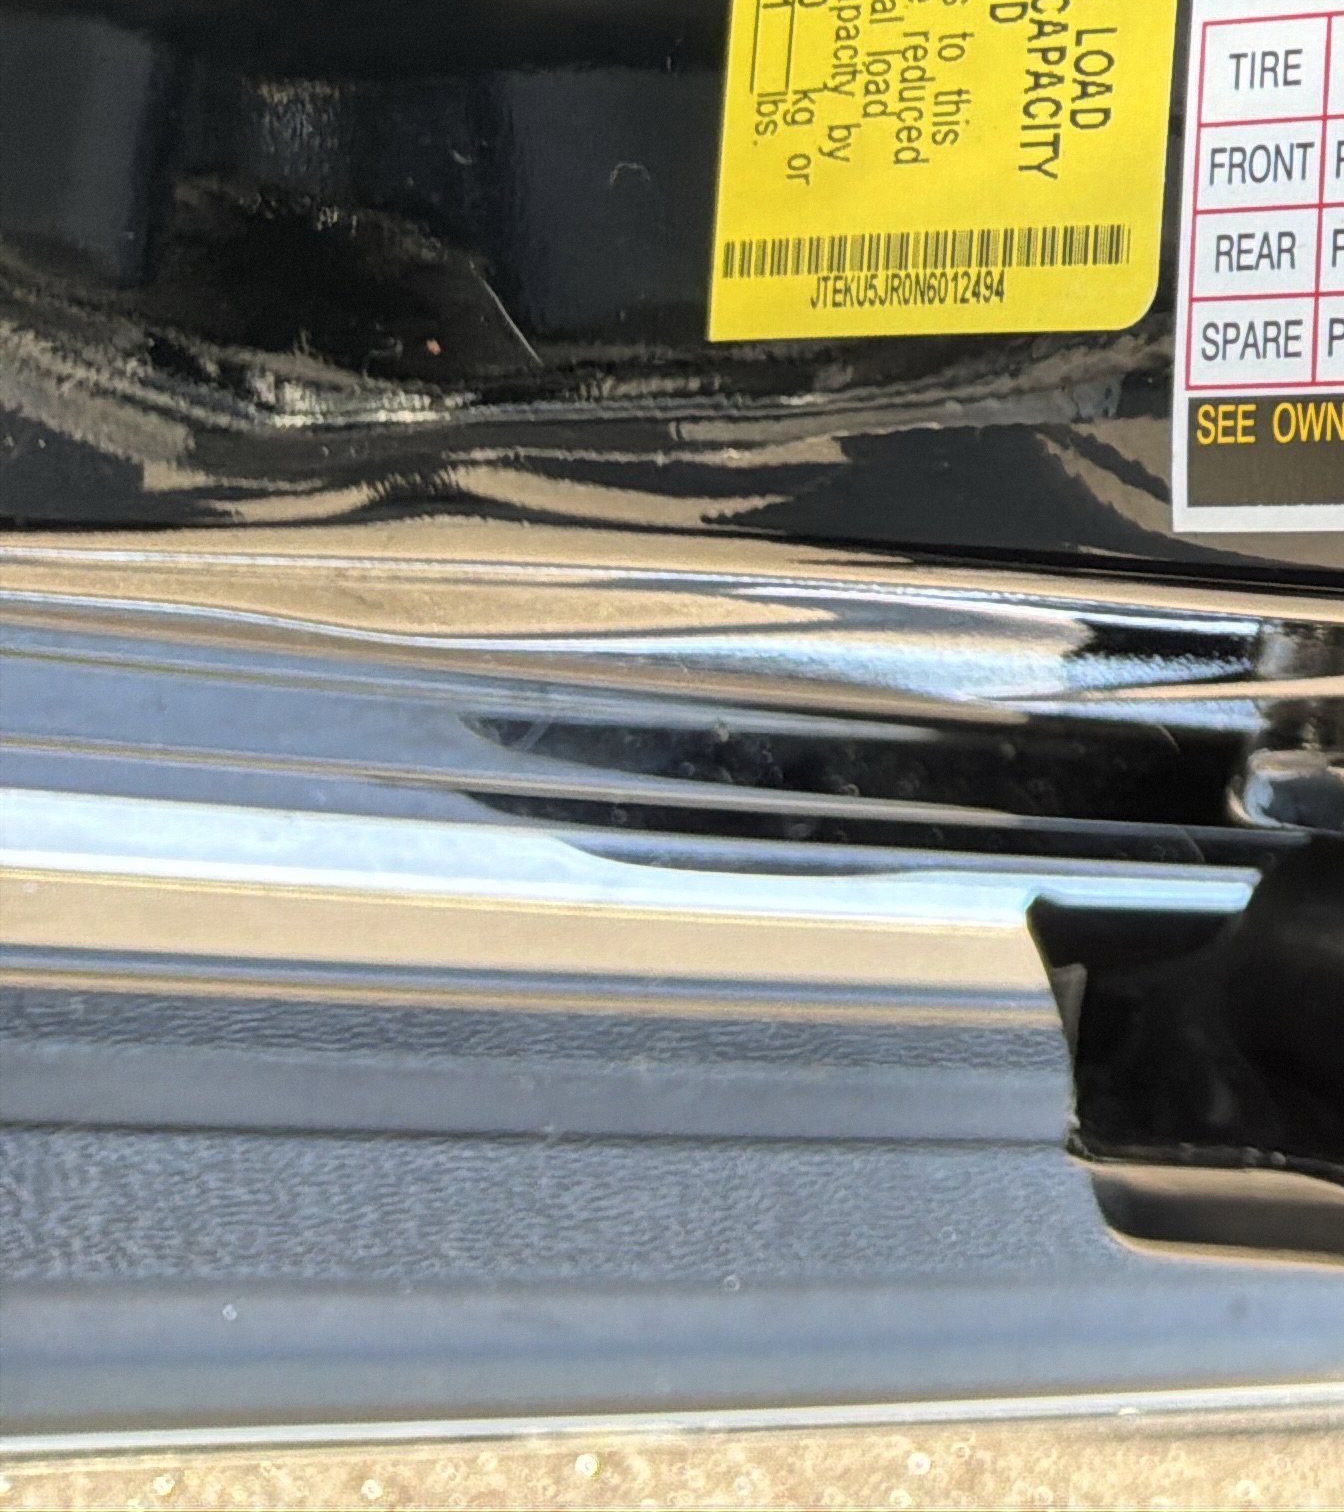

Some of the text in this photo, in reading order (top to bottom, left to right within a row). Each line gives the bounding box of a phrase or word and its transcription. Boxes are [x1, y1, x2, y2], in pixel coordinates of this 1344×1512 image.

[937, 31, 973, 62] to
[862, 50, 896, 118] load
[1069, 27, 1117, 130] LOAD
[1229, 49, 1303, 90] TIRE
[892, 31, 935, 165] reduced
[931, 88, 970, 145] this
[1209, 142, 1315, 186] FRONT
[1215, 231, 1296, 273] REAR
[810, 269, 1005, 309] JTEKU5JR0N6012494
[1201, 319, 1303, 362] SPARE
[1196, 403, 1257, 446] SEE
